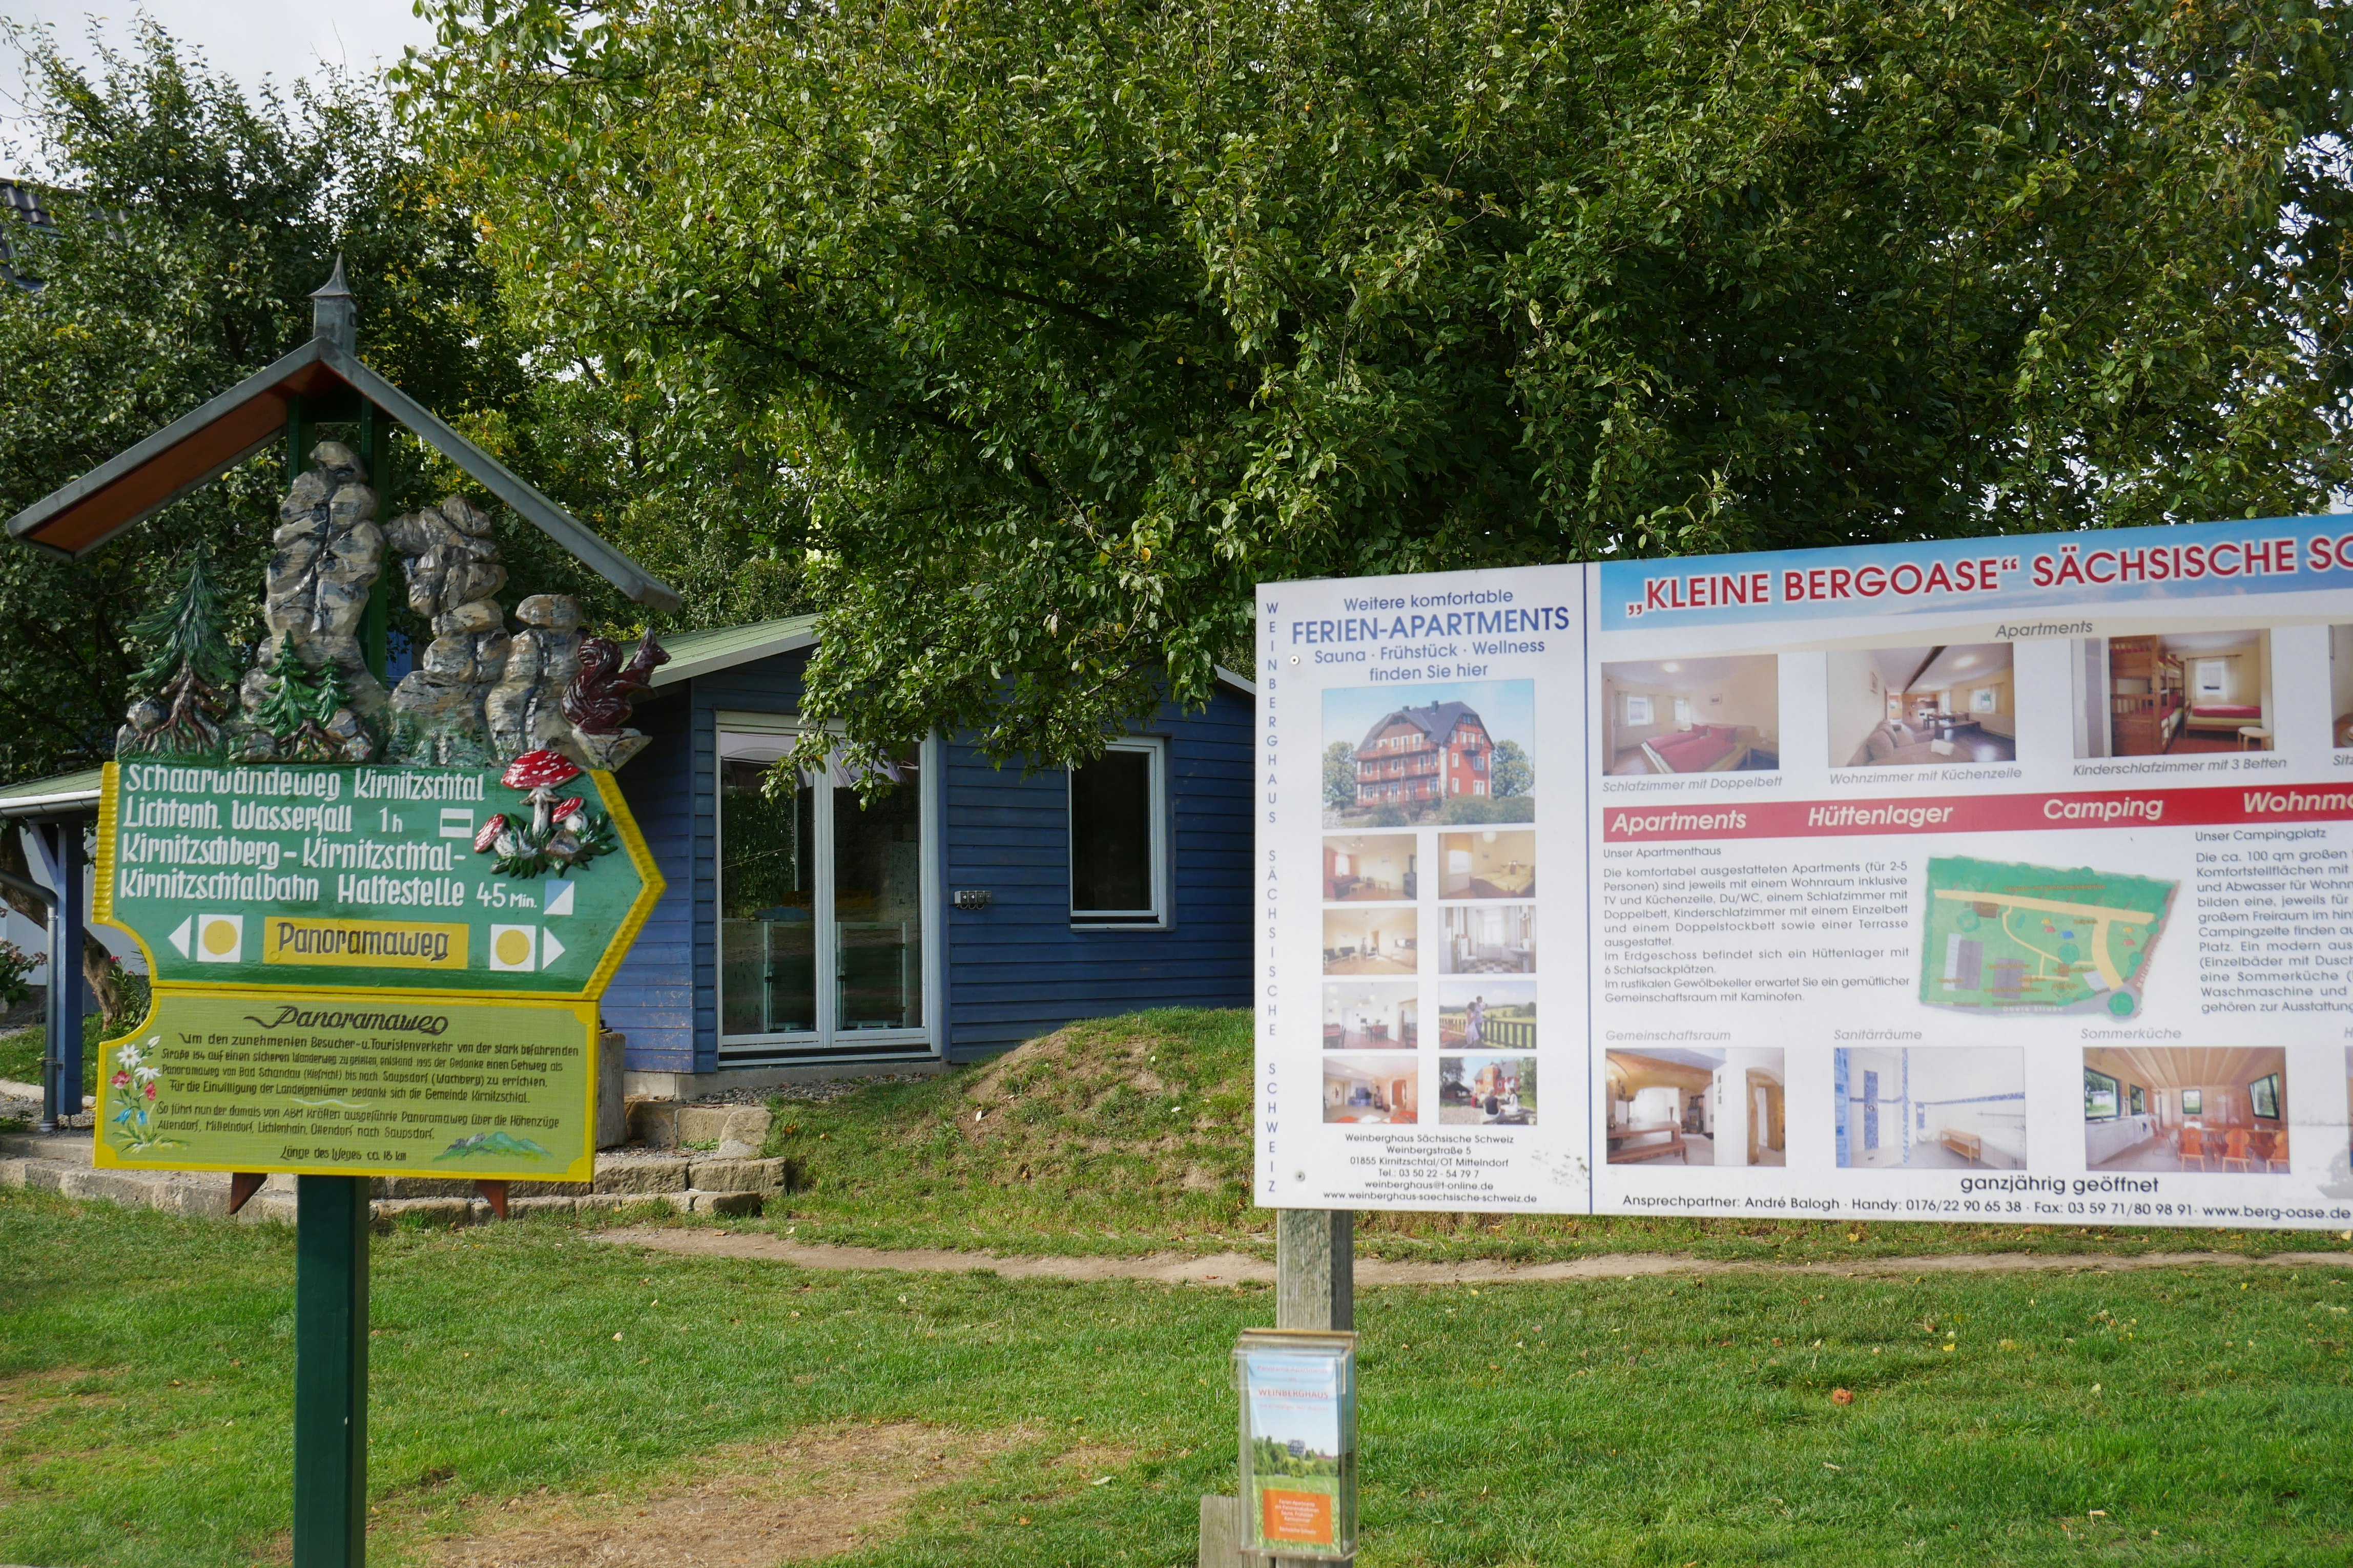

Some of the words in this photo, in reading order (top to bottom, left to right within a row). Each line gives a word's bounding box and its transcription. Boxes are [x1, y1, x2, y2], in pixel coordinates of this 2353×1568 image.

[2033, 539, 2296, 587] SÄCHSISCHE
[1344, 595, 1405, 612] Weitere
[1411, 590, 1513, 608] komfortable
[1292, 607, 1569, 644] FERIEN-APARTMENTS
[1996, 621, 2093, 638] Apartments
[1315, 650, 1366, 663] Sauna
[1381, 642, 1457, 660] Frühstück
[1472, 639, 1545, 655] Wellness
[1370, 666, 1423, 681] finden
[1427, 665, 1451, 679] Sie
[1457, 664, 1487, 677] hier
[1266, 601, 1278, 824] WEINBERGHAUS
[2073, 761, 2205, 776] Kinderschlafzimmer
[2207, 759, 2228, 771] mit
[2232, 759, 2239, 770] 3
[2243, 758, 2286, 769] Betten
[126, 763, 340, 802] Schaarwändeweg
[355, 768, 485, 801] Kirnitzschtal
[1603, 780, 1684, 792] Schlafzimmer
[1689, 778, 1707, 789] mit
[1710, 777, 1782, 789] Doppelbett
[1830, 772, 1914, 785] Wohnzimmer
[1918, 770, 1937, 783] mit
[1941, 768, 2022, 781] Küchenzeile
[123, 795, 222, 830] Lichtenh.
[232, 800, 353, 838] Wasserfall
[1612, 810, 1747, 835] Apartments
[1808, 805, 1953, 827] Hüttenlager
[2044, 797, 2163, 821] Camping
[2196, 831, 2229, 841] Unser
[2234, 829, 2326, 841] Campingplatz
[122, 833, 279, 870] Kirnitzschberg
[303, 838, 466, 871] Kirnitzschtal-
[1604, 849, 1632, 858] Unser
[1636, 847, 1721, 859] Apartmenthaus
[2196, 852, 2216, 862] Die
[2222, 853, 2241, 862] ca.
[2248, 851, 2267, 861] 100
[2273, 852, 2294, 863] qm
[2300, 849, 2346, 862] großen
[1604, 868, 1621, 877] Die
[1627, 867, 1696, 877] komfortabel
[1701, 864, 1787, 877] ausgestatteten
[1792, 862, 1860, 874] Apartments
[1866, 862, 1885, 873] (für
[1890, 861, 1907, 870] 2-5
[2197, 866, 2322, 877] Komfortstellflächen
[2328, 865, 2348, 874] mit
[121, 868, 319, 901] Kirnitzschtalbahn
[338, 874, 465, 906] Haltestelle
[476, 882, 506, 908] 45
[510, 893, 537, 908] Min.
[1604, 882, 1659, 892] Personen)
[1663, 881, 1685, 890] sind
[1689, 880, 1726, 891] jeweils
[1730, 880, 1746, 888] mit
[1751, 879, 1787, 888] einem
[1791, 877, 1854, 887] Wohnraum
[1859, 876, 1907, 886] inklusive
[1604, 910, 1669, 920] Doppelbett,
[1674, 907, 1785, 917] Kinderschlafzimmer
[1790, 907, 1807, 915] mit
[1811, 906, 1848, 915] einem
[1853, 905, 1908, 914] Einzelbett
[278, 924, 449, 961] Panoramaweg
[1267, 850, 1278, 1036] SÄCHSISCHE
[1605, 979, 1618, 988] Im
[1621, 979, 1670, 988] rustikalen
[1674, 978, 1751, 988] Gewölbekeller
[1755, 977, 1799, 987] erwartet
[1803, 977, 1818, 986] Sie
[1822, 977, 1838, 986] ein
[1842, 976, 1909, 988] gemütlicher
[1605, 993, 1717, 1002] Gemeinschaftsraum
[1721, 993, 1737, 1001] mit
[1741, 991, 1804, 1002] Kaminofen.
[244, 1006, 448, 1035] Panoramaweg
[1605, 1029, 1731, 1042] Gemeinschaftsraum
[1834, 1029, 1922, 1041] Sanitärräume
[2080, 1028, 2181, 1040] Sommerküche
[169, 1079, 184, 1092] Für
[187, 1081, 200, 1092] die
[203, 1081, 257, 1095] Einwilligung
[260, 1083, 274, 1094] der
[276, 1083, 347, 1097] Landeigentümer
[352, 1088, 386, 1097] bedankt
[390, 1089, 405, 1099] sich
[410, 1088, 421, 1099] die
[425, 1088, 467, 1101] Gemeinde
[472, 1090, 530, 1103] Kirnitzschtal.
[157, 1101, 168, 1114] So
[172, 1102, 192, 1115] führt
[195, 1105, 211, 1115] nun
[214, 1104, 226, 1116] der
[230, 1104, 260, 1117] damals
[264, 1107, 279, 1118] von
[283, 1109, 303, 1118] ABM
[344, 1110, 397, 1122] ausgeführte
[402, 1111, 467, 1125] Panoramaweg
[494, 1115, 506, 1125] die
[510, 1115, 559, 1129] Höhenzüge
[358, 1126, 379, 1137] nach
[385, 1127, 435, 1139] Saupsdorf.
[1266, 1063, 1278, 1193] SCHWEIZ
[1346, 1134, 1414, 1144] Weinberghaus
[1417, 1134, 1472, 1143] Sächsische
[1475, 1135, 1514, 1144] Schweiz
[280, 1146, 309, 1160] Länge
[315, 1147, 329, 1158] des
[333, 1148, 361, 1161] Weges
[384, 1151, 392, 1161] 18
[396, 1151, 406, 1161] km
[1386, 1145, 1462, 1156] Weinbergstraße
[1466, 1146, 1471, 1155] 5
[1350, 1157, 1376, 1166] 01855
[1379, 1157, 1453, 1166] Kirnitzschtal/OT
[1456, 1158, 1509, 1167] Mittelndorf
[1365, 1181, 1493, 1191] weinberghaus@t-online.de
[1960, 1176, 2066, 1194] ganzjährig
[2073, 1177, 2159, 1193] geöffnet
[1324, 1190, 1537, 1203] www.weinberghaus-saechsische-schweiz.de
[1623, 1195, 1740, 1208] Ansprechpartner:
[1745, 1196, 1786, 1209] André
[1790, 1197, 1840, 1210] Balogh
[1852, 1199, 1902, 1212] Handy:
[1906, 1199, 1959, 1213] 0176/22
[1964, 1200, 1979, 1212] 90
[1984, 1200, 2000, 1212] 65
[2005, 1201, 2021, 1212] 38
[2034, 1202, 2063, 1214] Fax:
[2068, 1202, 2084, 1214] 03
[2090, 1202, 2105, 1214] 59
[2111, 1202, 2151, 1217] 71/80
[2156, 1203, 2172, 1216] 98
[2202, 1205, 2350, 1220] www.berg-oase.de
[1258, 1389, 1328, 1399] WEINBERGHAUS
